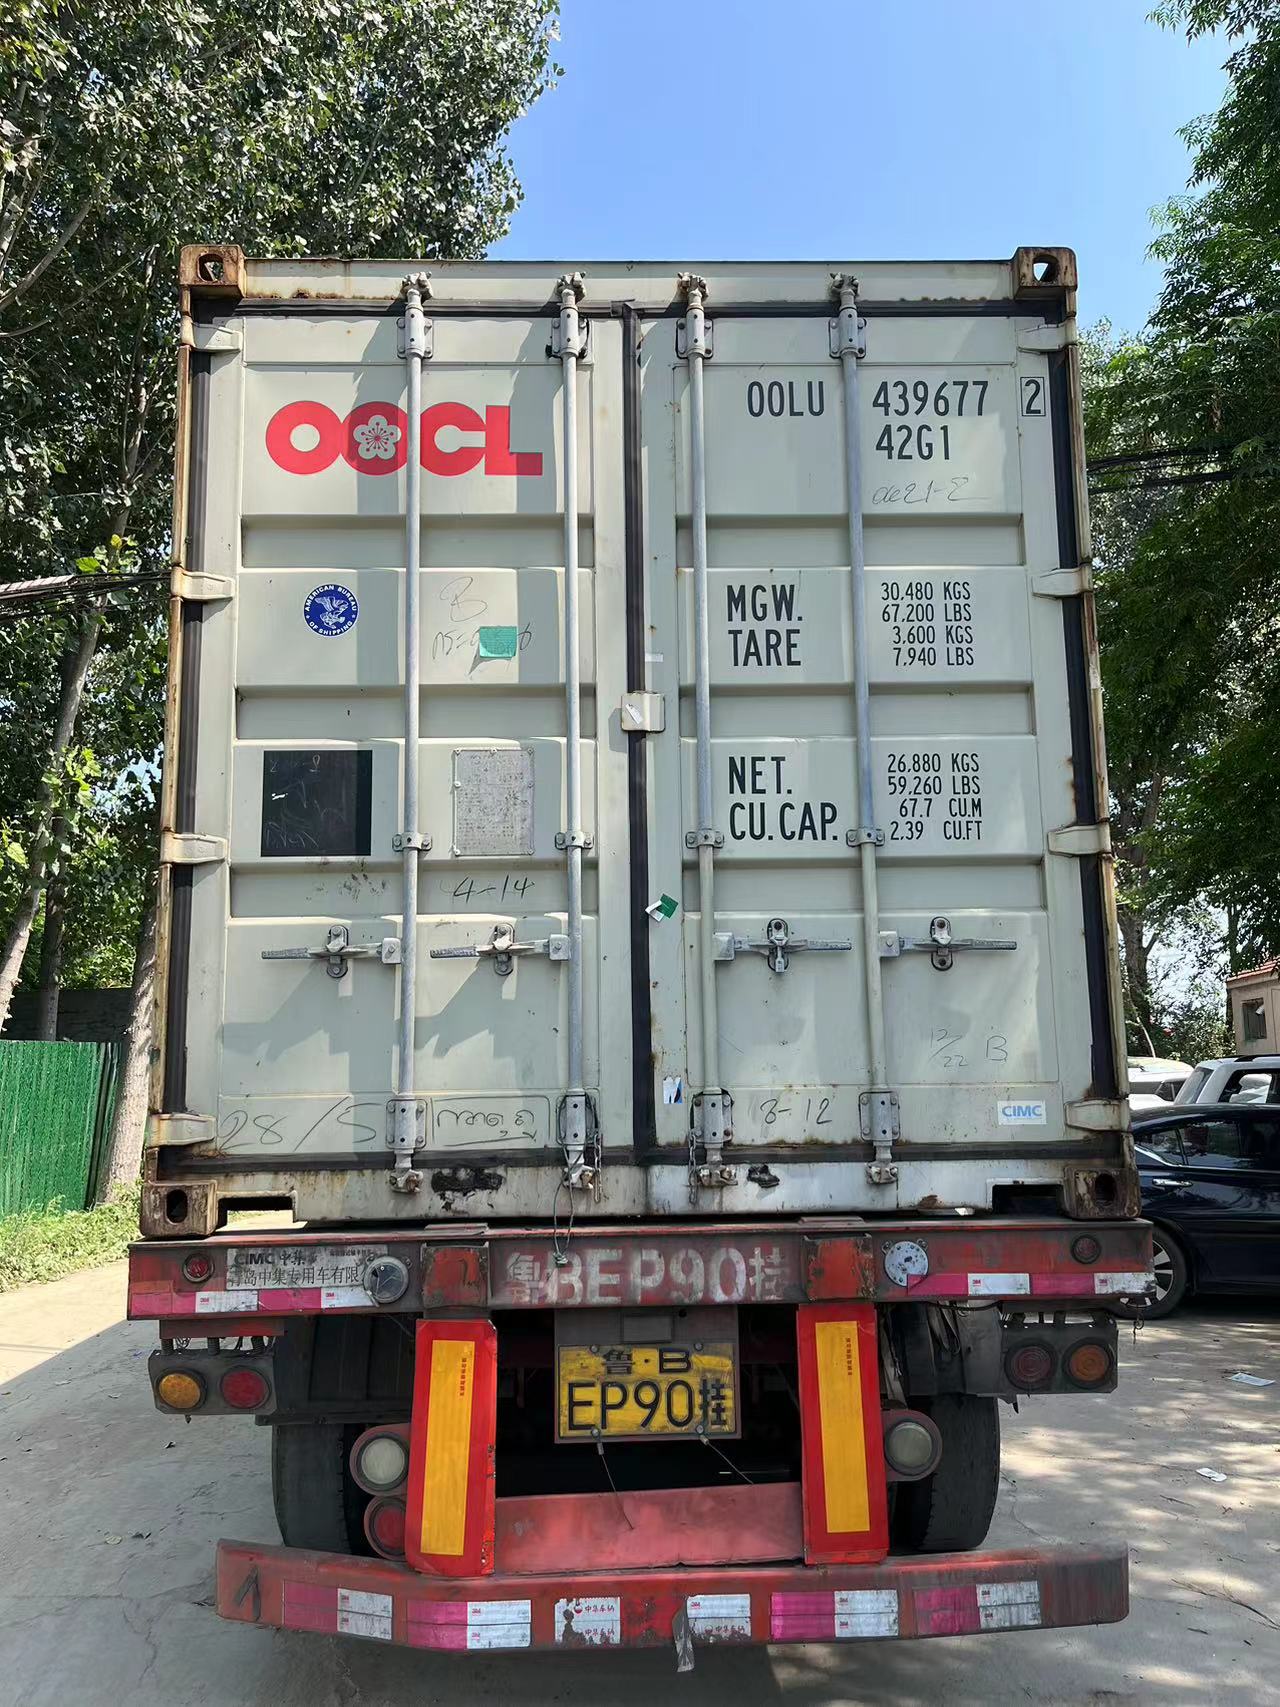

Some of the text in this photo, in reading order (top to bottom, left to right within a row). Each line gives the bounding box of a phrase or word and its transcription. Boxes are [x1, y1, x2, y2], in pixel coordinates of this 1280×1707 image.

[746, 380, 1042, 418] OOLU 439677 2
[265, 400, 543, 477] OOCL
[875, 424, 951, 461] 42G1
[305, 585, 357, 612] AMERICAN BUREAU
[881, 581, 971, 601] 30,480 KGS
[726, 584, 803, 622] MGW.
[882, 603, 972, 623] 67,200 LBS
[309, 620, 353, 636] OF SHIPPING
[892, 625, 973, 645] 3,600 KGS
[728, 629, 802, 667] TARE
[893, 647, 975, 667] 7,940 LBS
[887, 753, 980, 774] 26,880 KGS
[728, 756, 793, 795] NET.
[888, 776, 981, 796] 59,260 LBS
[899, 798, 982, 818] 67.7 CU.M
[729, 802, 838, 841] CU.CAP.
[943, 821, 982, 841] CU.FT
[1002, 1105, 1043, 1118] CIMC
[234, 1252, 275, 1265] CIMC
[228, 1266, 364, 1287] 青岛中集专用车有限
